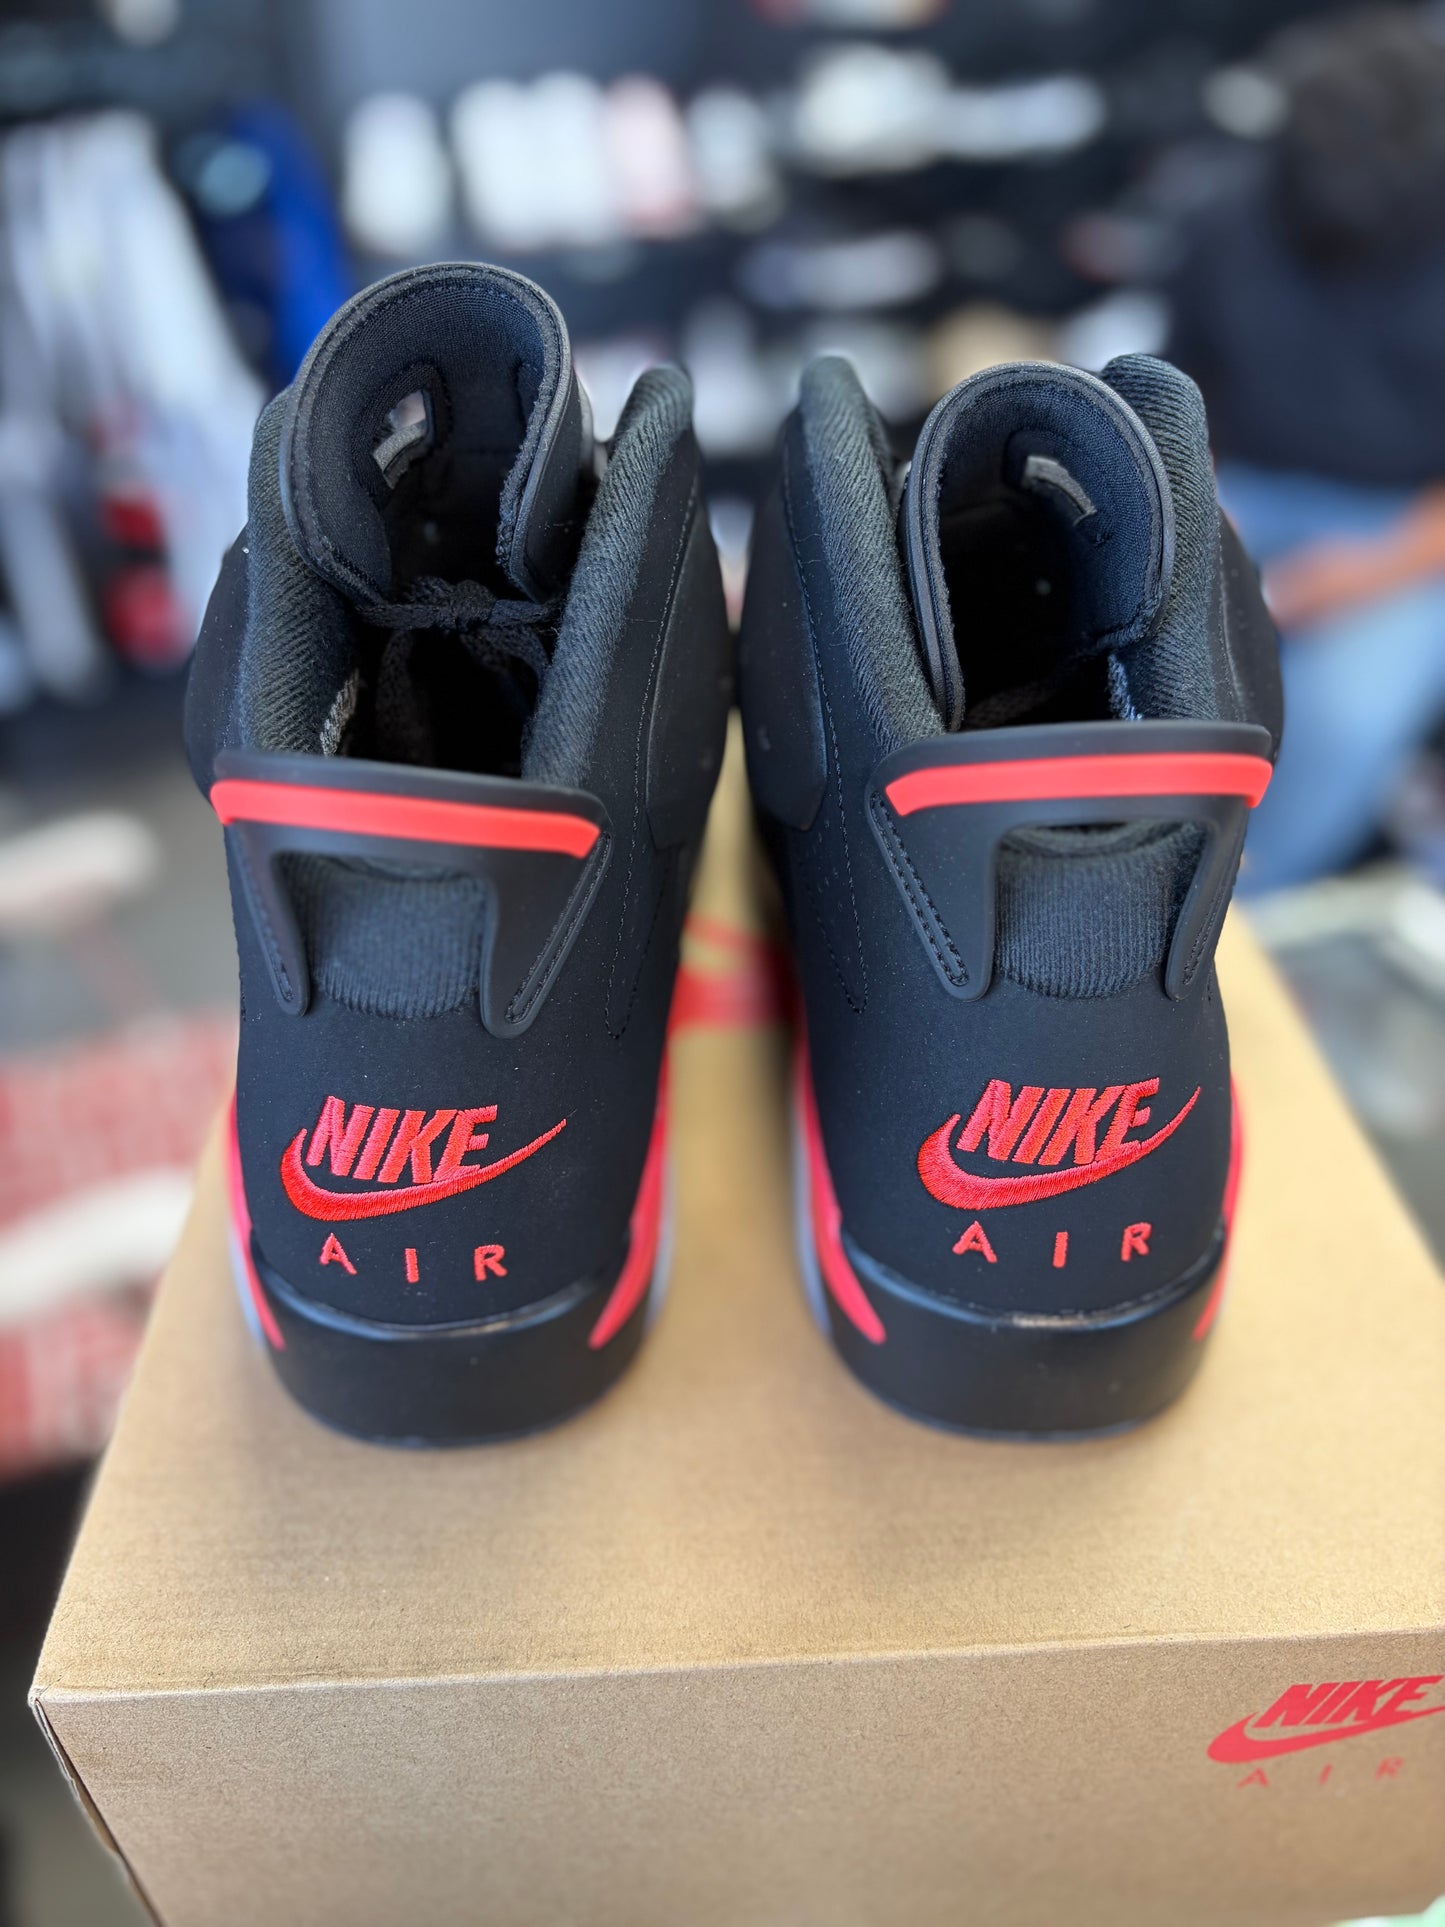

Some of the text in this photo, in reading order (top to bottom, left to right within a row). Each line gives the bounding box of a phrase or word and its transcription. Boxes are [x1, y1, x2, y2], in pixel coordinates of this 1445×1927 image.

[306, 1096, 498, 1184] NIKE
[956, 1078, 1160, 1166] NIKE
[319, 1233, 508, 1283] AIR
[952, 1221, 1152, 1268] AIR
[1252, 1675, 1445, 1728] NIKE
[1236, 1757, 1404, 1790] AIR
